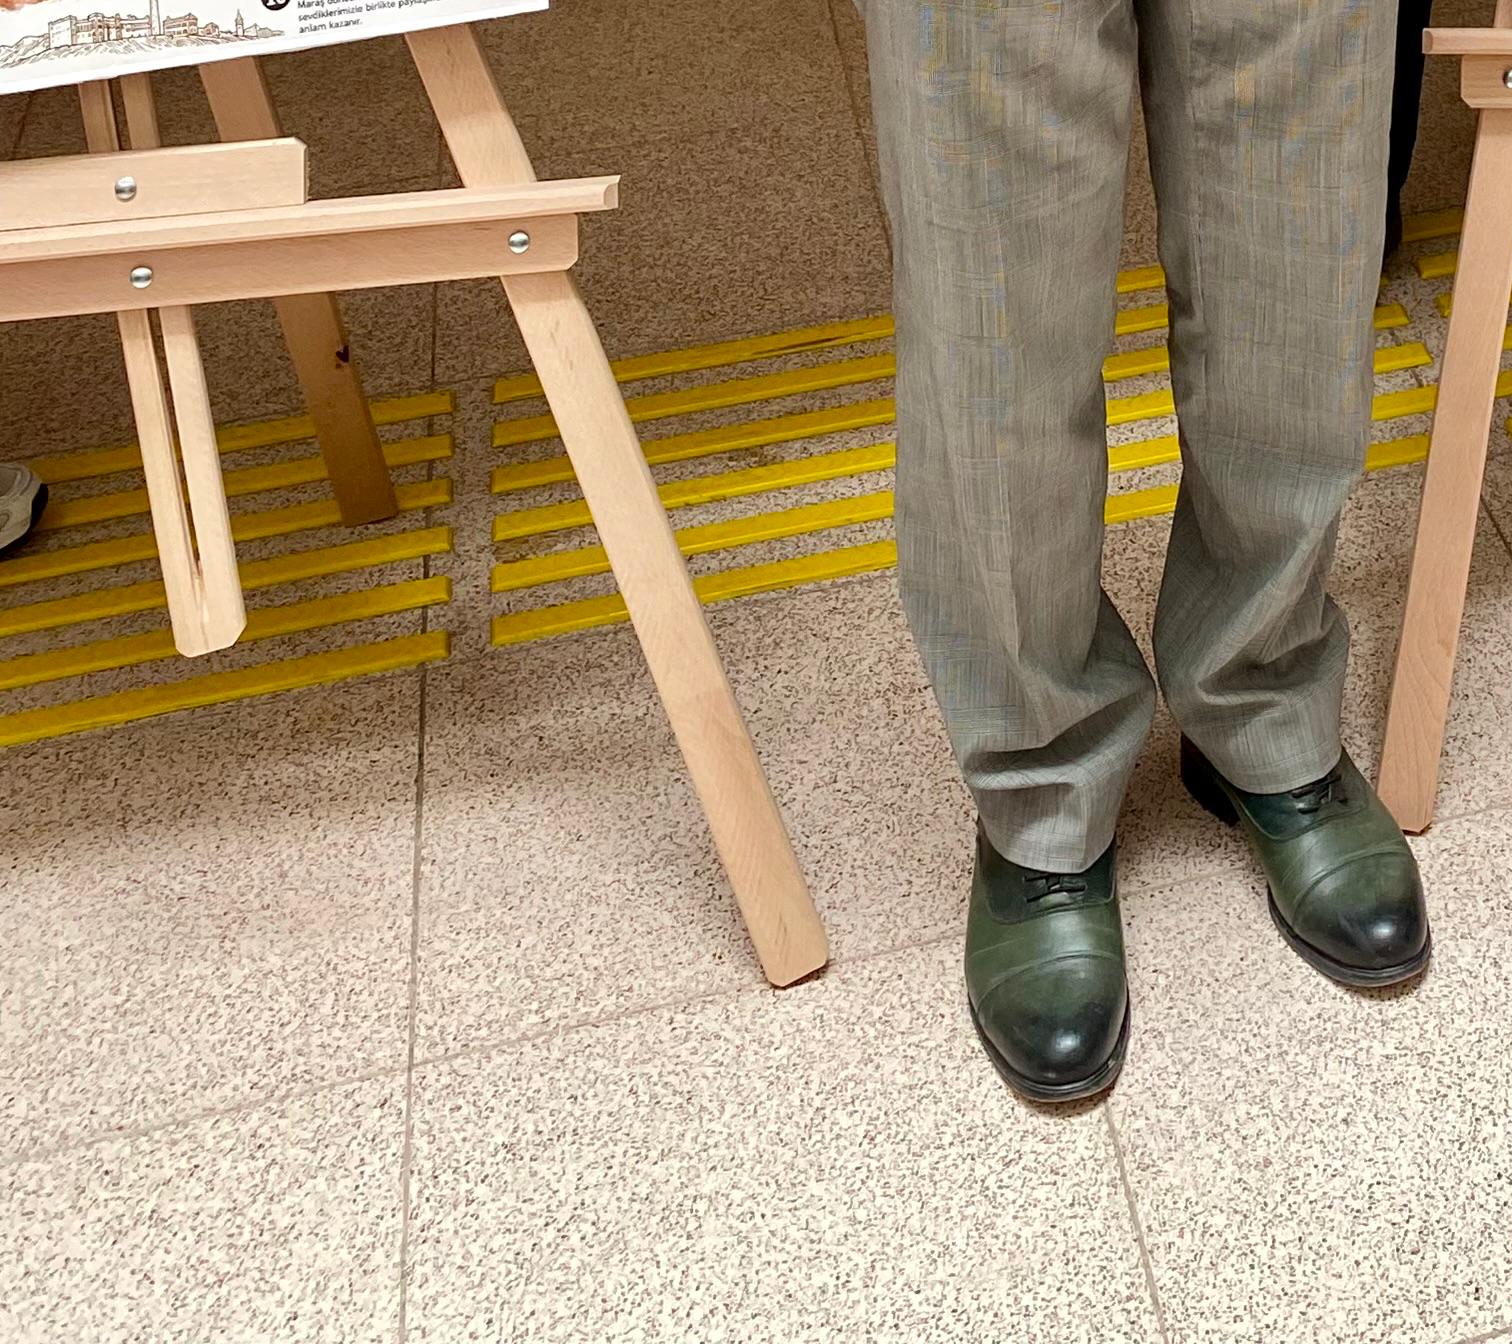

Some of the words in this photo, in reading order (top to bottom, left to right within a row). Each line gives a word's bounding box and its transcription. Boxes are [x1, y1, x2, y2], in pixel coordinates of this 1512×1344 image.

[299, 6, 363, 22] sevdiklerimizle
[366, 0, 396, 12] birlikte
[299, 23, 327, 33] anlam
